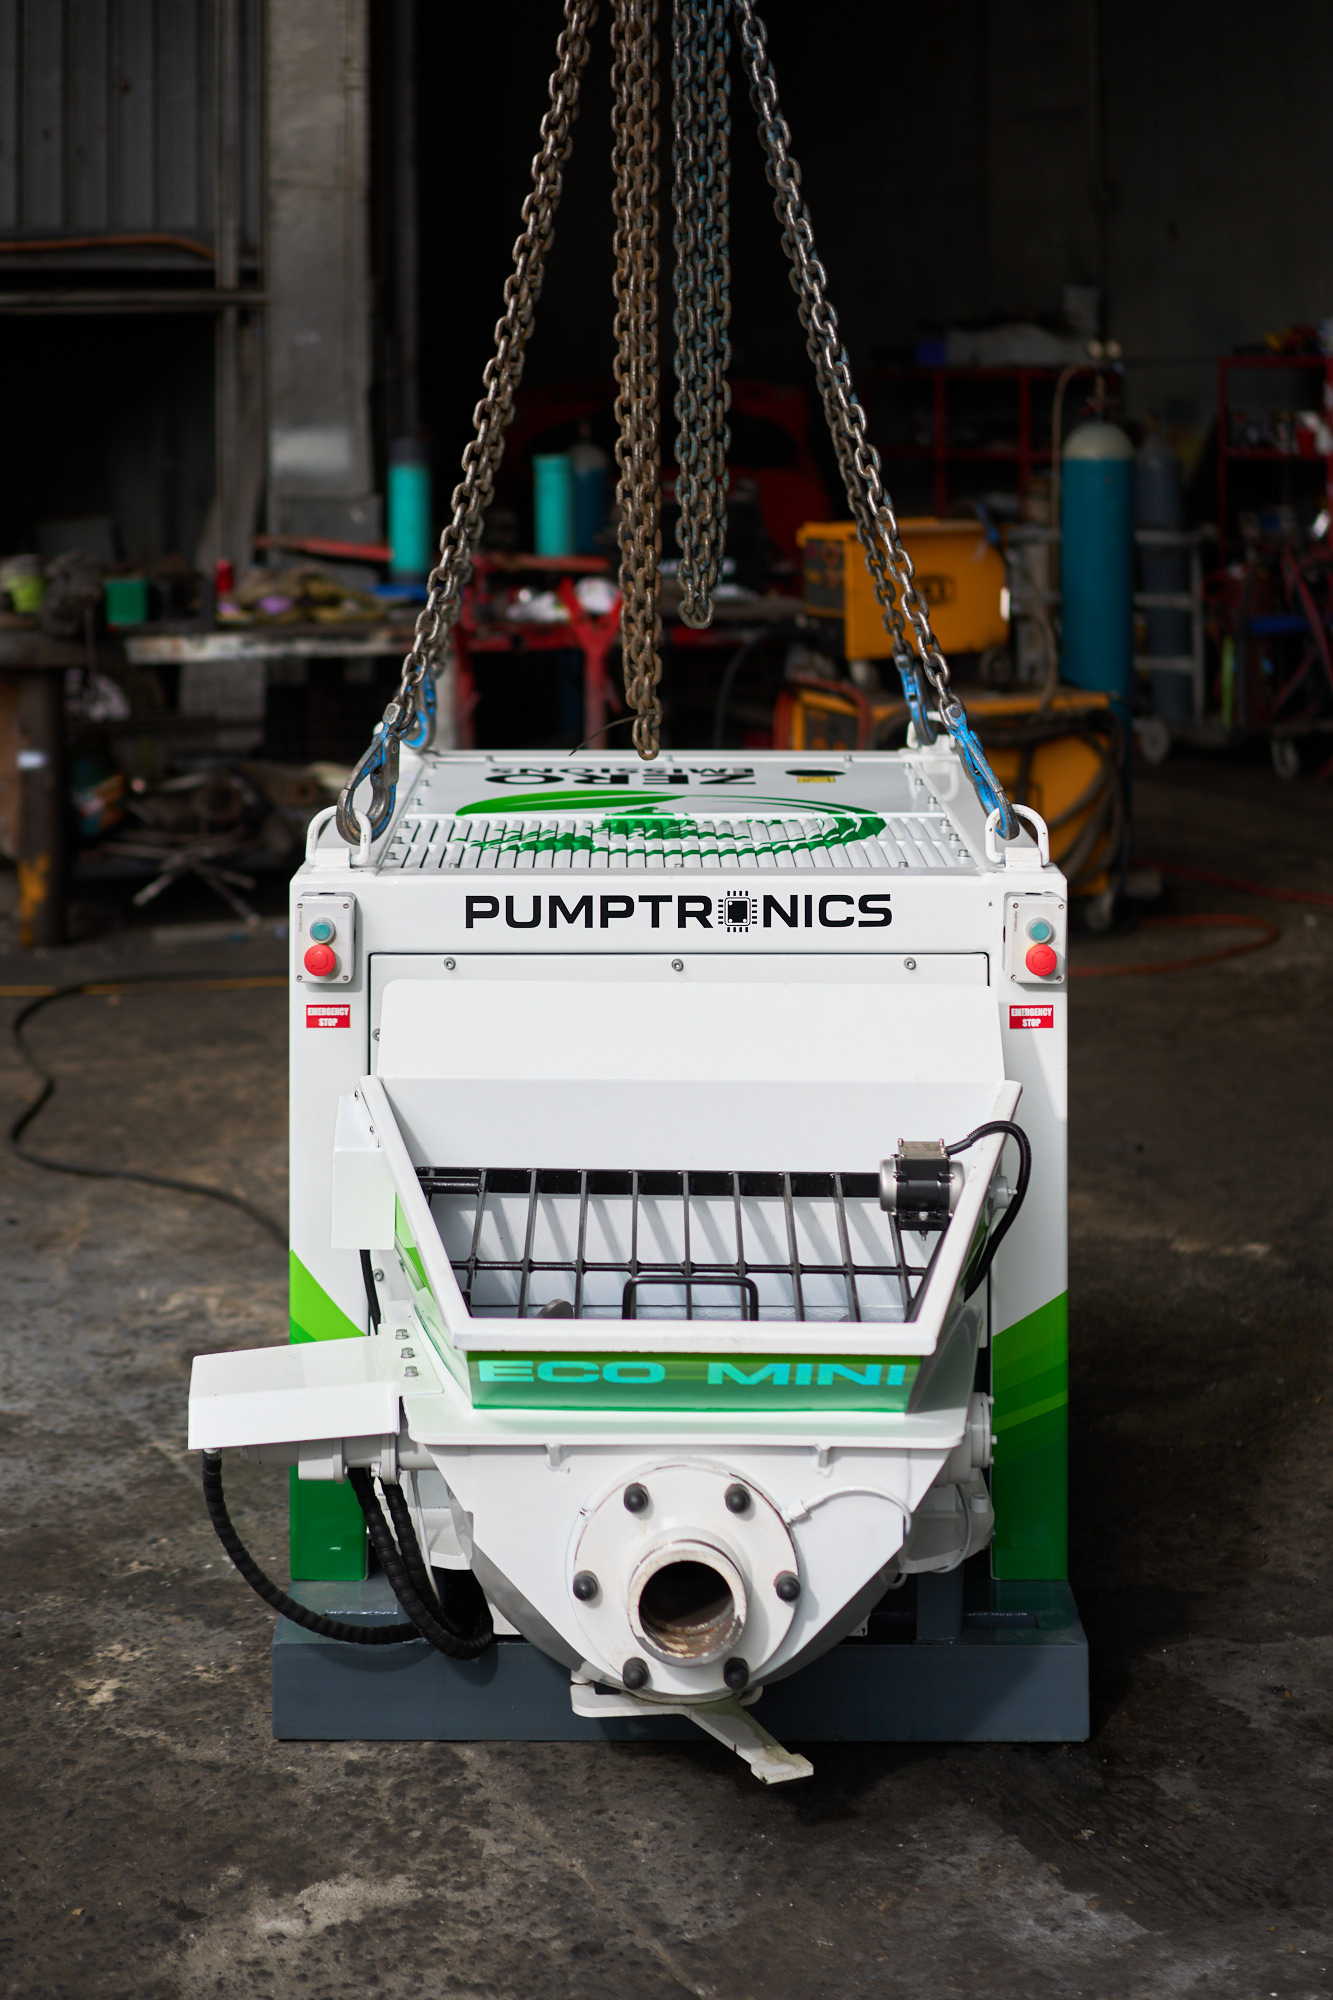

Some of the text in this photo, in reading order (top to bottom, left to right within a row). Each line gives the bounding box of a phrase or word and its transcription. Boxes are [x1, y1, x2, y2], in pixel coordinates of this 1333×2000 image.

[485, 774, 756, 785] ZERO
[307, 1007, 350, 1016] EMERGENCY
[1011, 1007, 1053, 1017] EMERGENCY
[318, 1017, 338, 1027] STOP
[1022, 1018, 1042, 1027] STOP
[479, 1360, 906, 1386] ECO MINI
